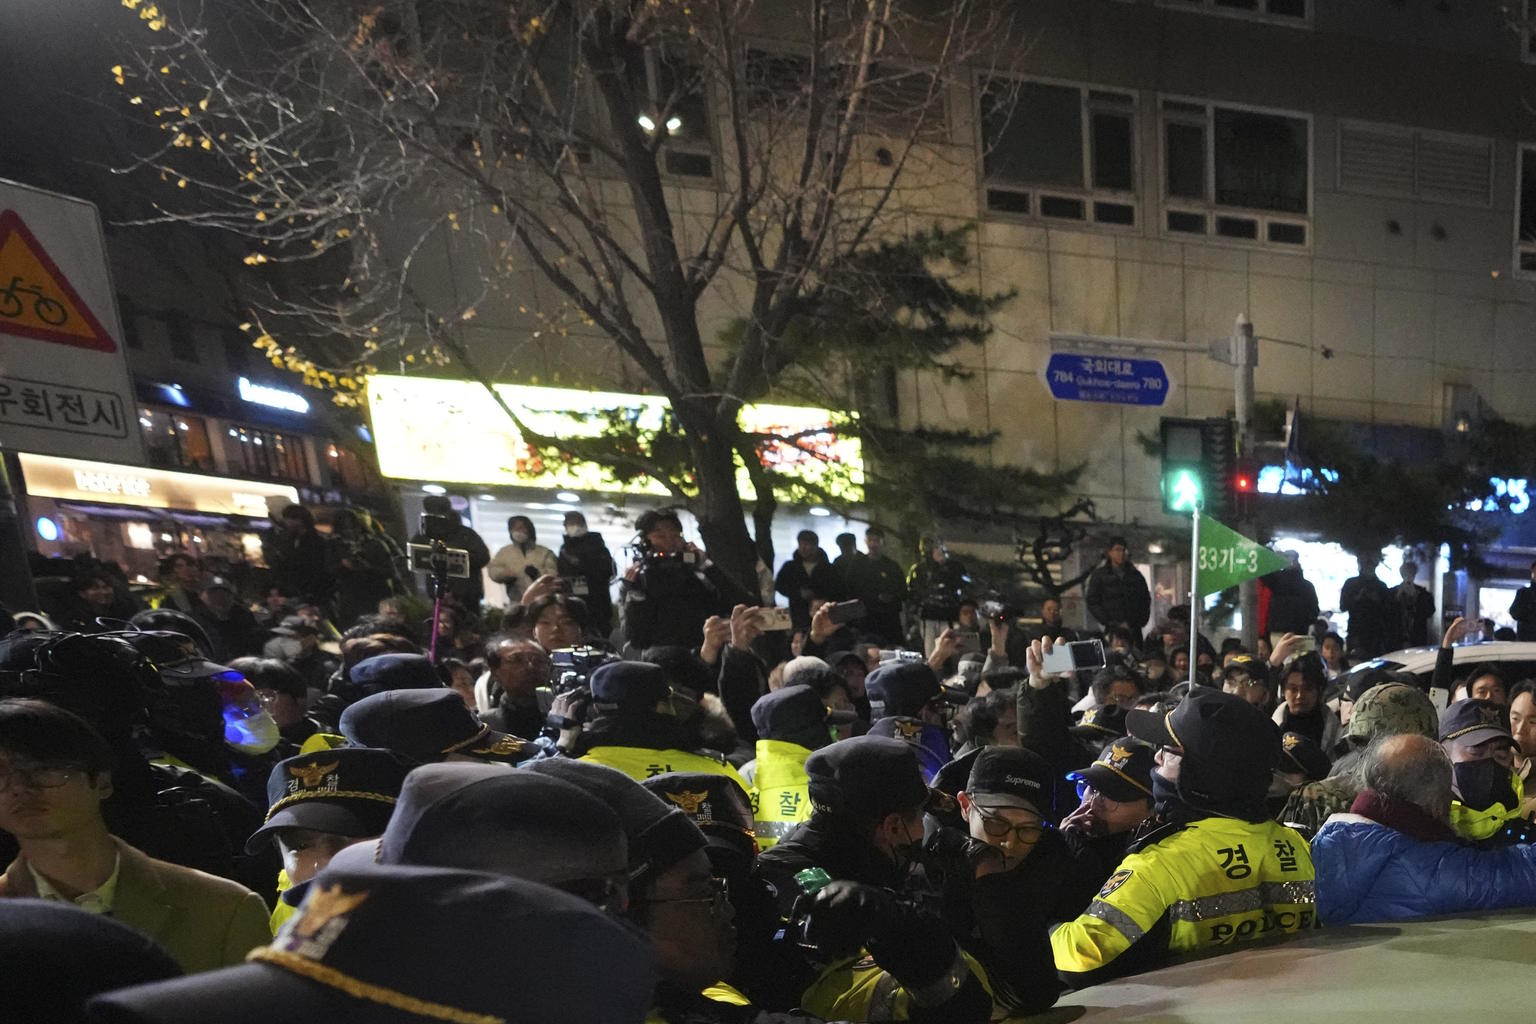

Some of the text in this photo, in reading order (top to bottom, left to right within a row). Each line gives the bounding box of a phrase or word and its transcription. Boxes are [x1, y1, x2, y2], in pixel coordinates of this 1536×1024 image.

[1081, 358, 1134, 376] 국회대로
[1199, 546, 1258, 573] 33기-3
[1005, 774, 1040, 789] Supreme
